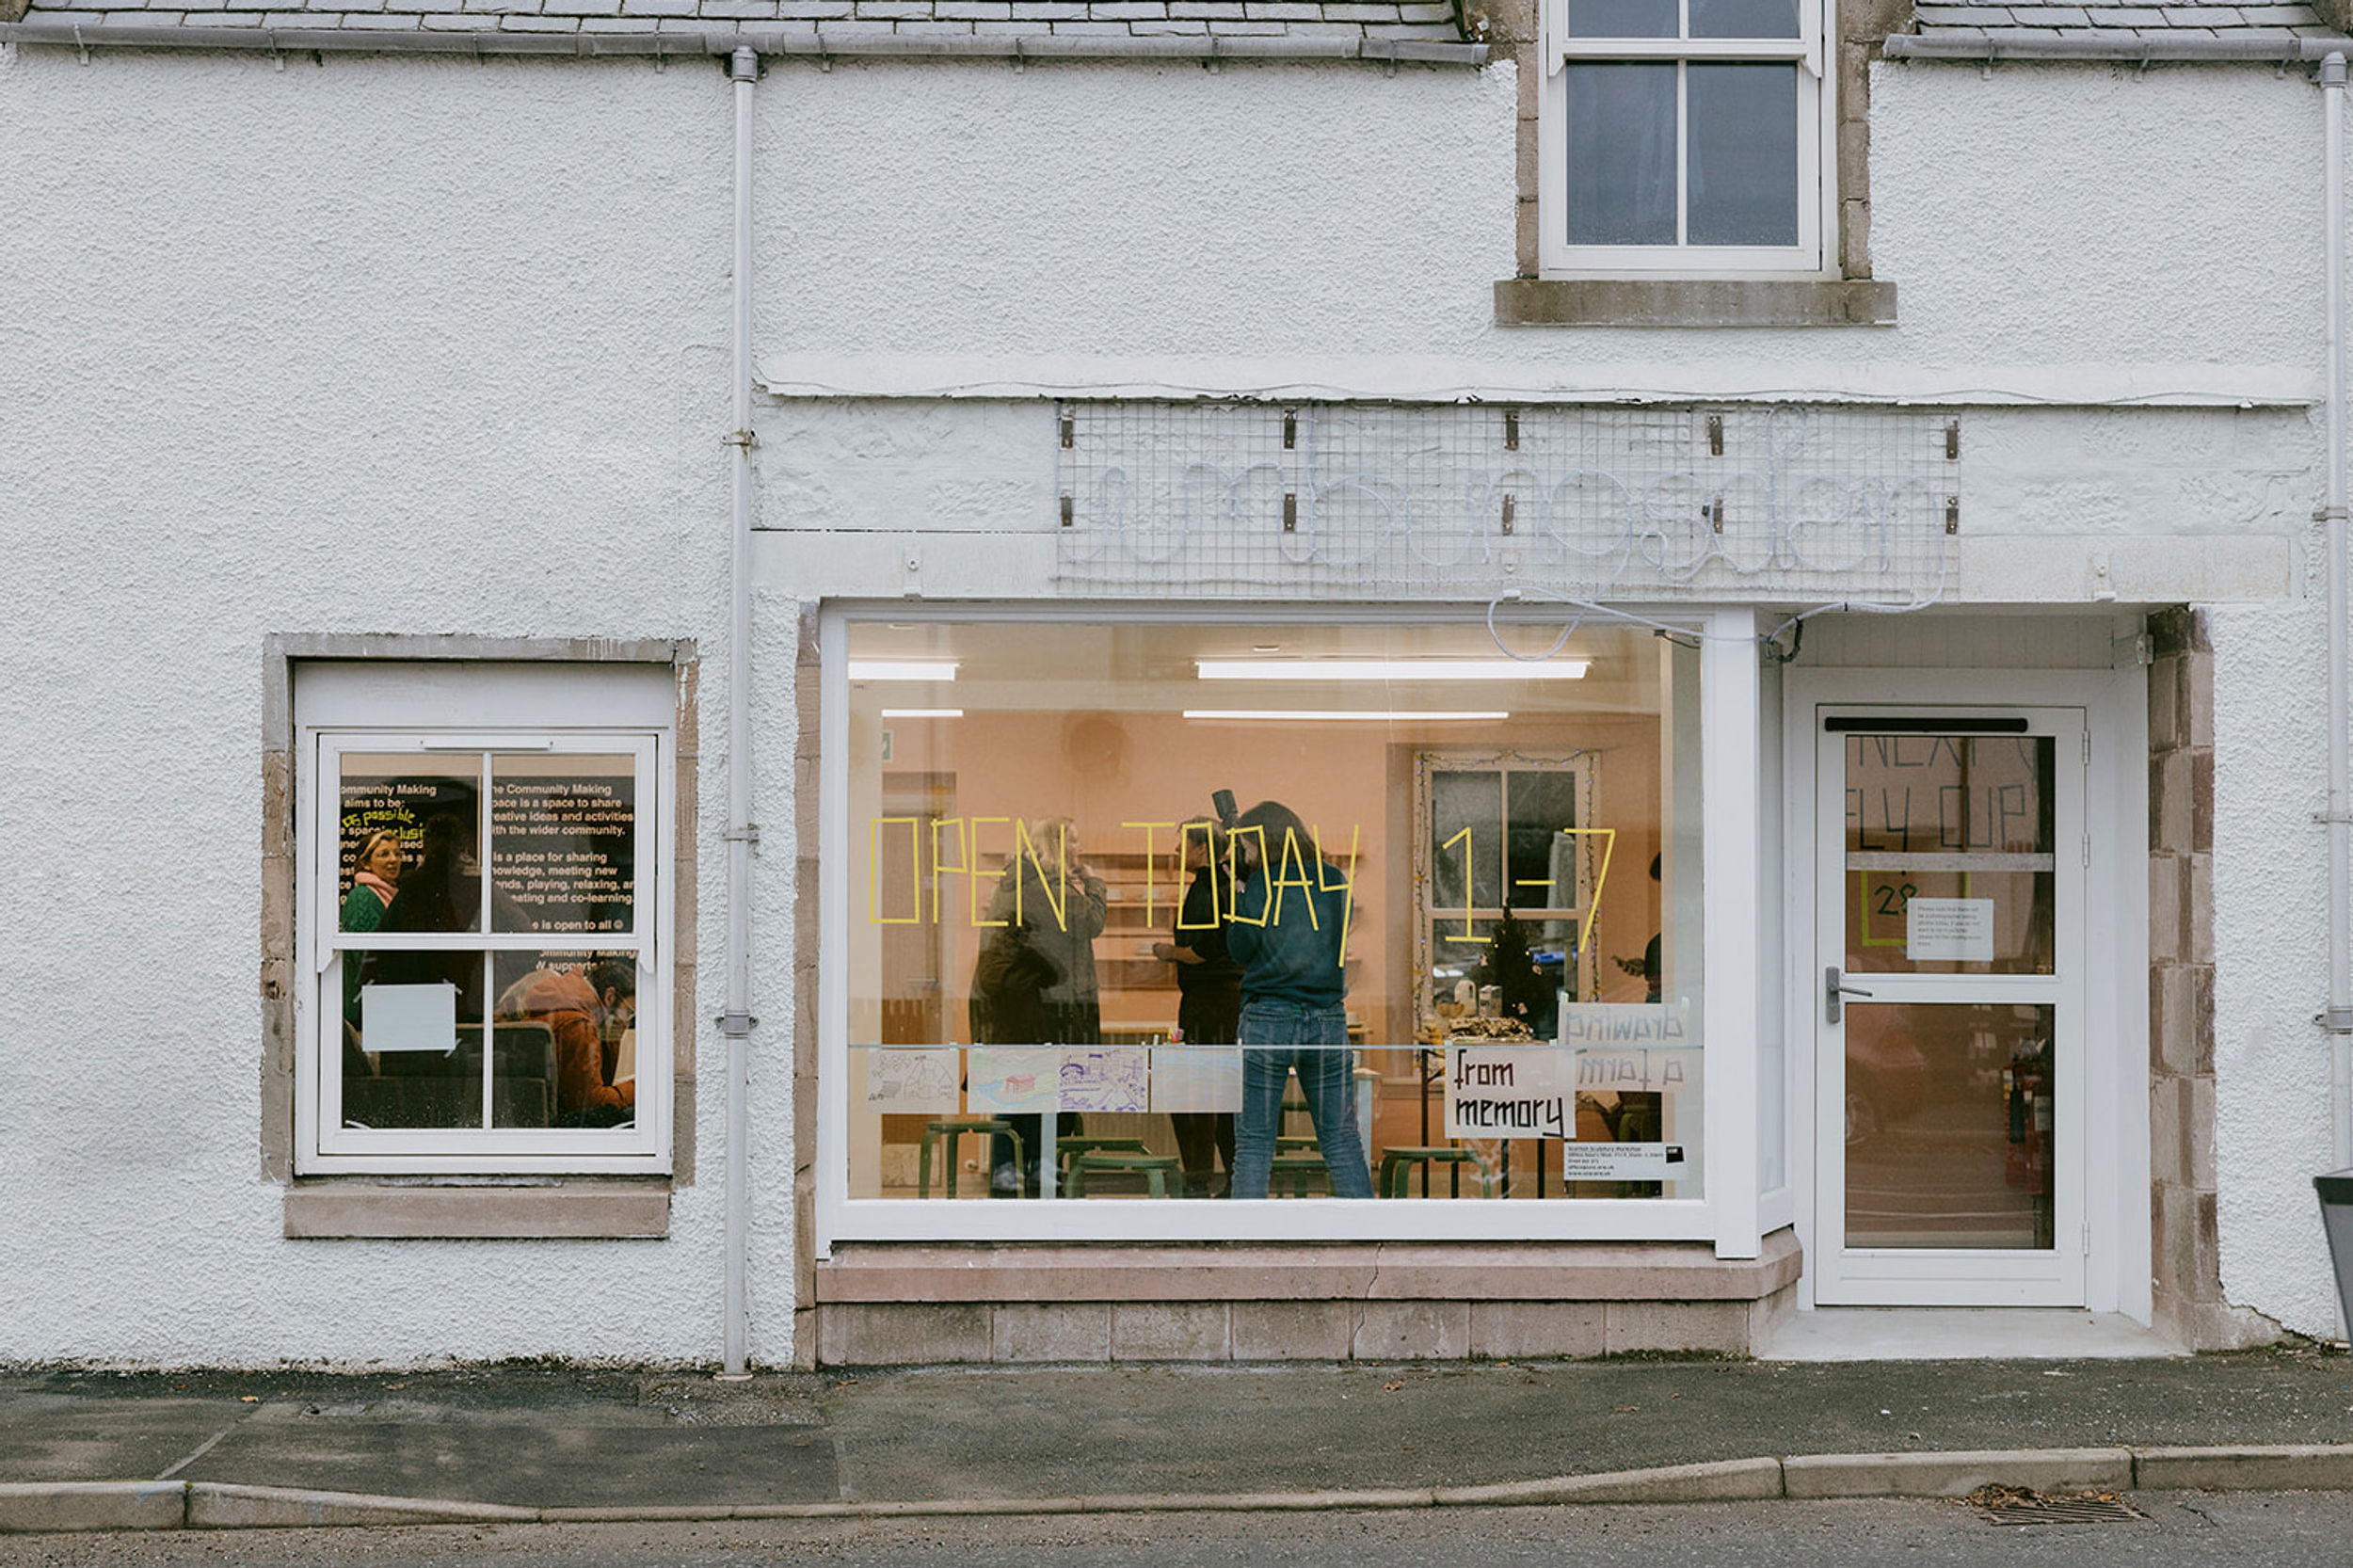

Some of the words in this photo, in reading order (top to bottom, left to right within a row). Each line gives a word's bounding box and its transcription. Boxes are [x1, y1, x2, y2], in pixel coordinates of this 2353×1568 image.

[397, 784, 437, 796] Making
[506, 783, 569, 796] Community
[572, 784, 612, 796] Making
[344, 798, 370, 808] aims
[373, 798, 385, 808] to
[387, 798, 405, 808] be:
[520, 798, 530, 808] is
[532, 799, 539, 808] a
[542, 799, 574, 810] space
[577, 798, 588, 808] to
[591, 797, 622, 808] share
[362, 808, 415, 825] possible
[529, 810, 558, 822] ideas
[561, 810, 583, 822] and
[584, 810, 633, 822] activities
[1940, 785, 2025, 850] CUP
[509, 824, 526, 835] the
[529, 824, 559, 835] wider
[562, 824, 626, 838] community.
[493, 851, 503, 862] is
[505, 853, 513, 862] a
[516, 851, 545, 864] place
[548, 851, 563, 862] for
[566, 851, 608, 864] sharing
[548, 865, 592, 877] meeting
[595, 867, 617, 875] new
[527, 879, 570, 891] playing,
[573, 879, 620, 891] relaxing,
[547, 892, 568, 903] and
[870, 817, 1066, 932] OPEN
[1121, 822, 1359, 968] TODAY
[542, 920, 552, 930] is
[553, 920, 582, 931] open
[584, 920, 596, 930] to
[598, 920, 611, 930] all
[1454, 1048, 1513, 1090] from
[1455, 1096, 1564, 1138] memory
